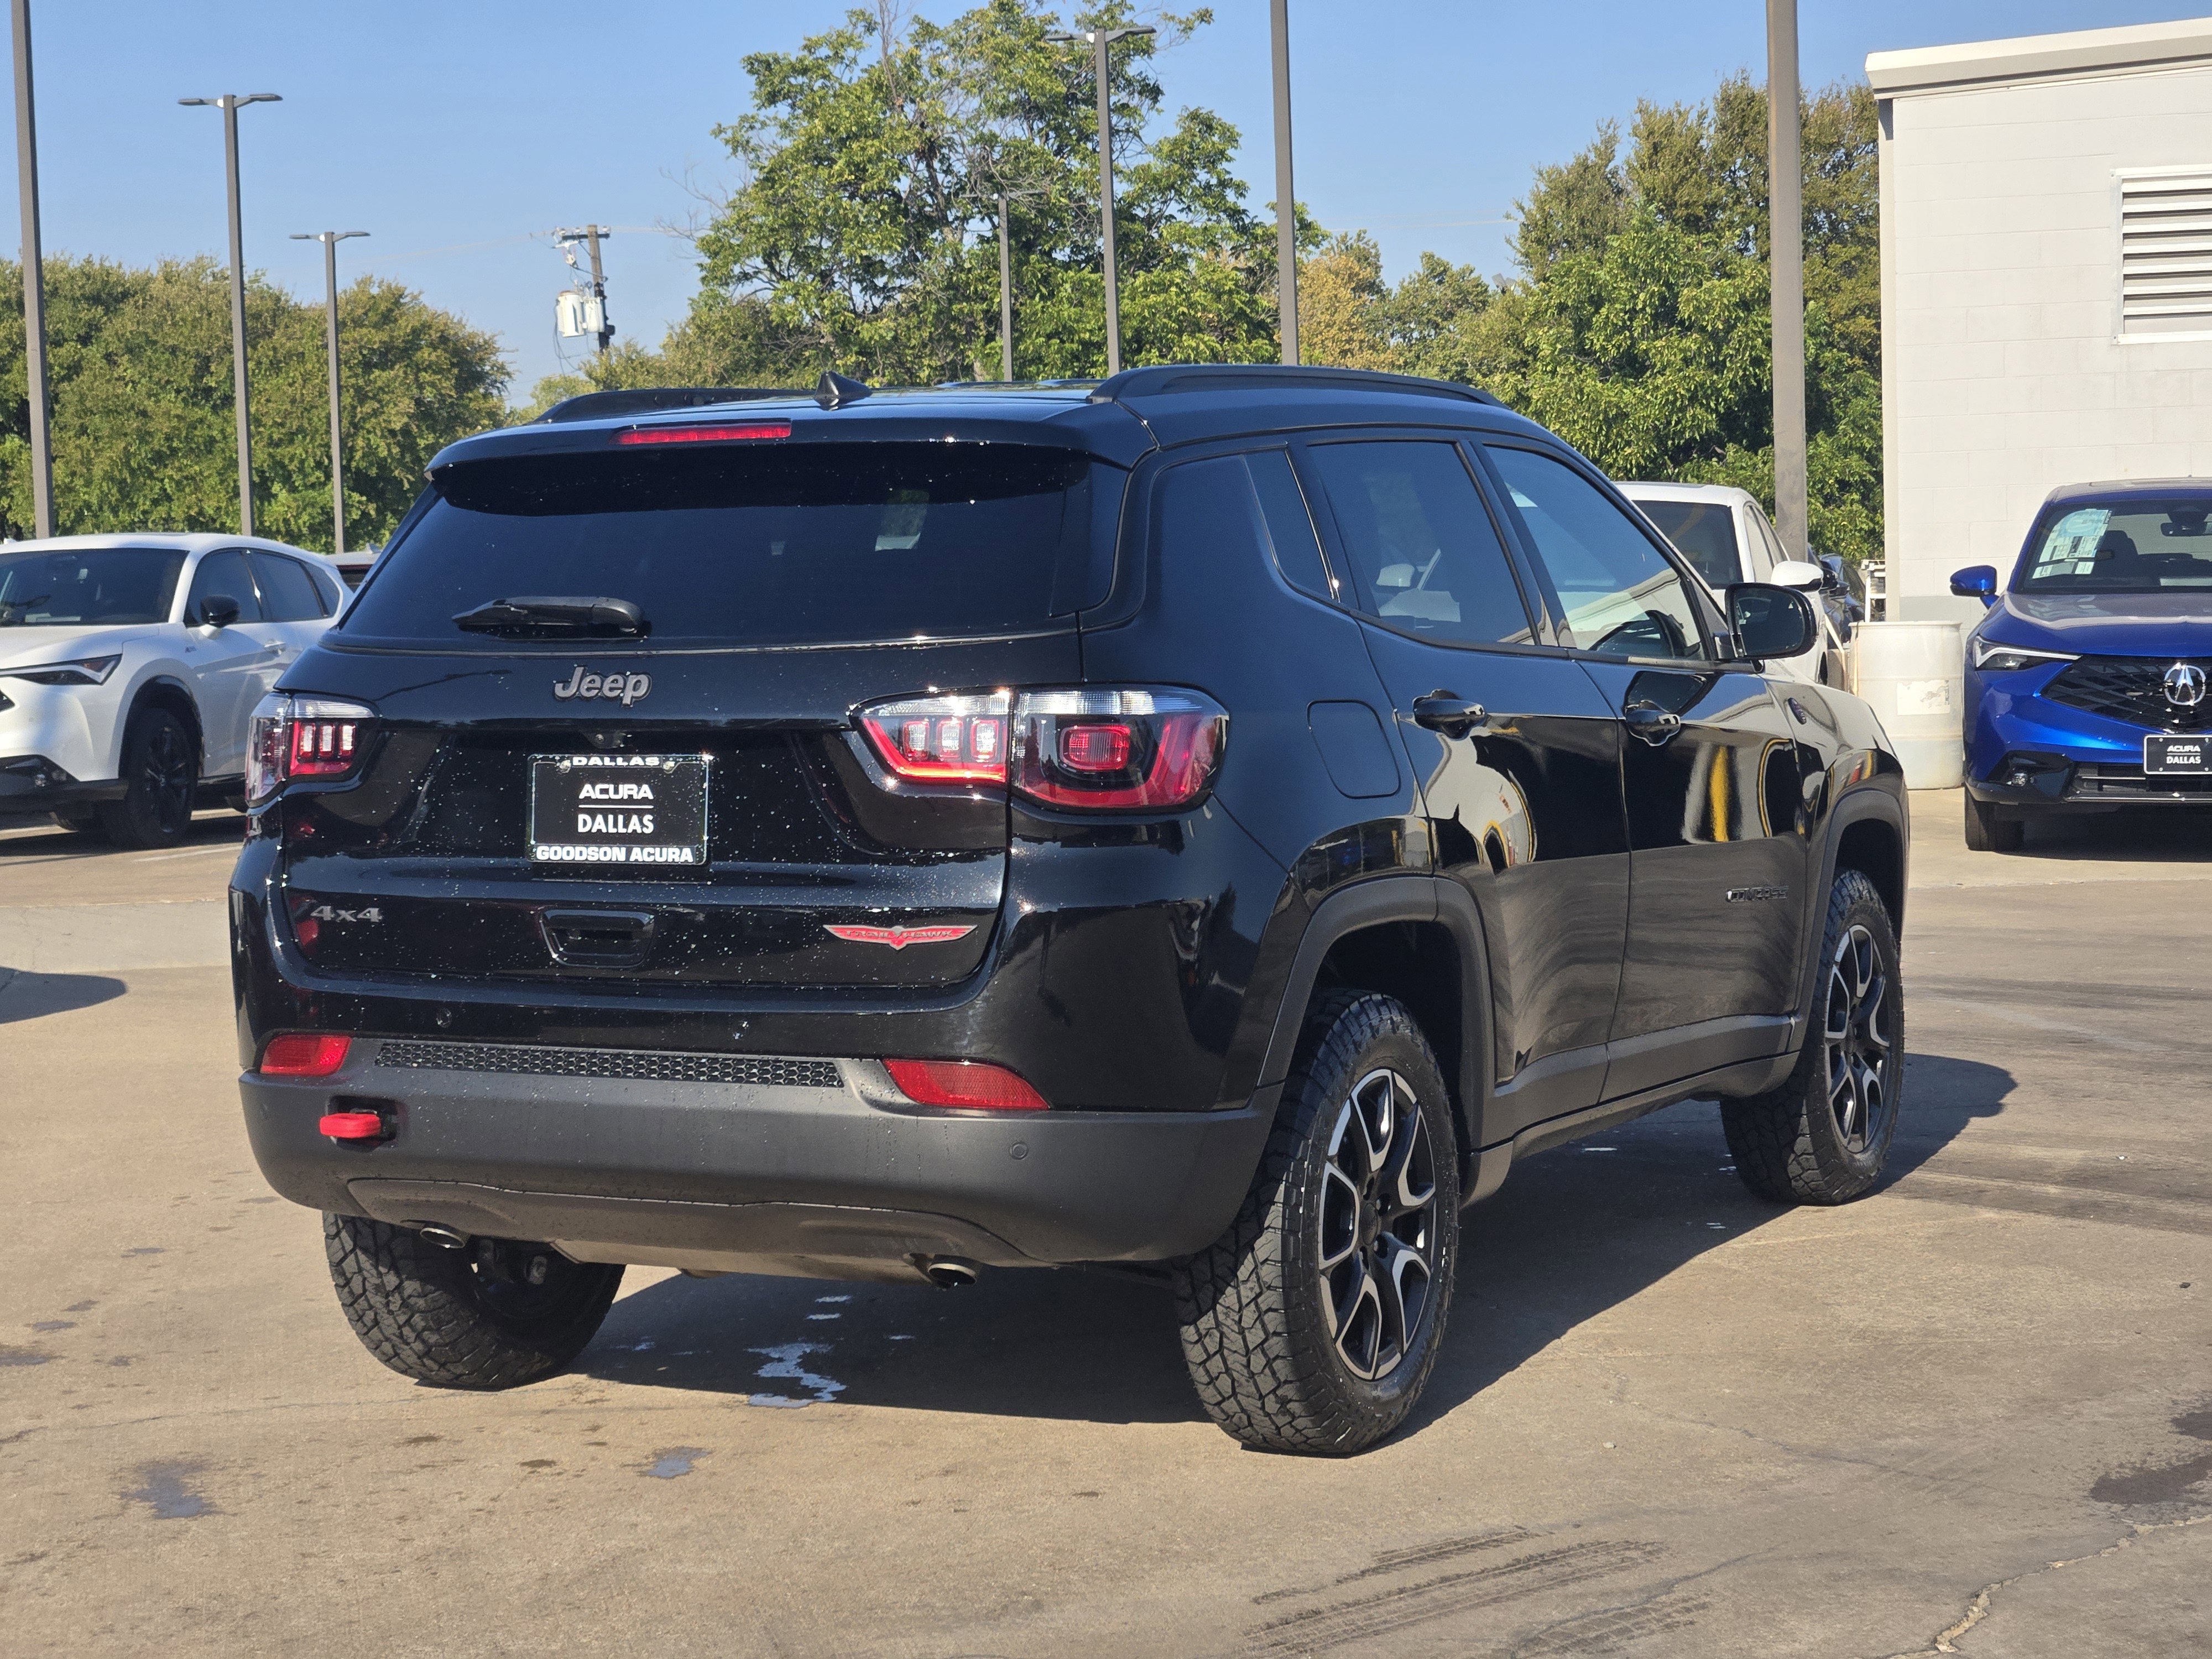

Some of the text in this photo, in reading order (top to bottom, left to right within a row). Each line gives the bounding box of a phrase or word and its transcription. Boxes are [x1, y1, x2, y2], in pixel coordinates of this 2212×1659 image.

[554, 665, 651, 706] Jeep
[573, 757, 660, 766] DALLAS
[2166, 756, 2201, 764] DALLAS
[578, 784, 654, 800] ACURA
[577, 813, 654, 834] DALLAS
[536, 846, 693, 863] GOODSON ACURA
[310, 905, 383, 922] 4x4
